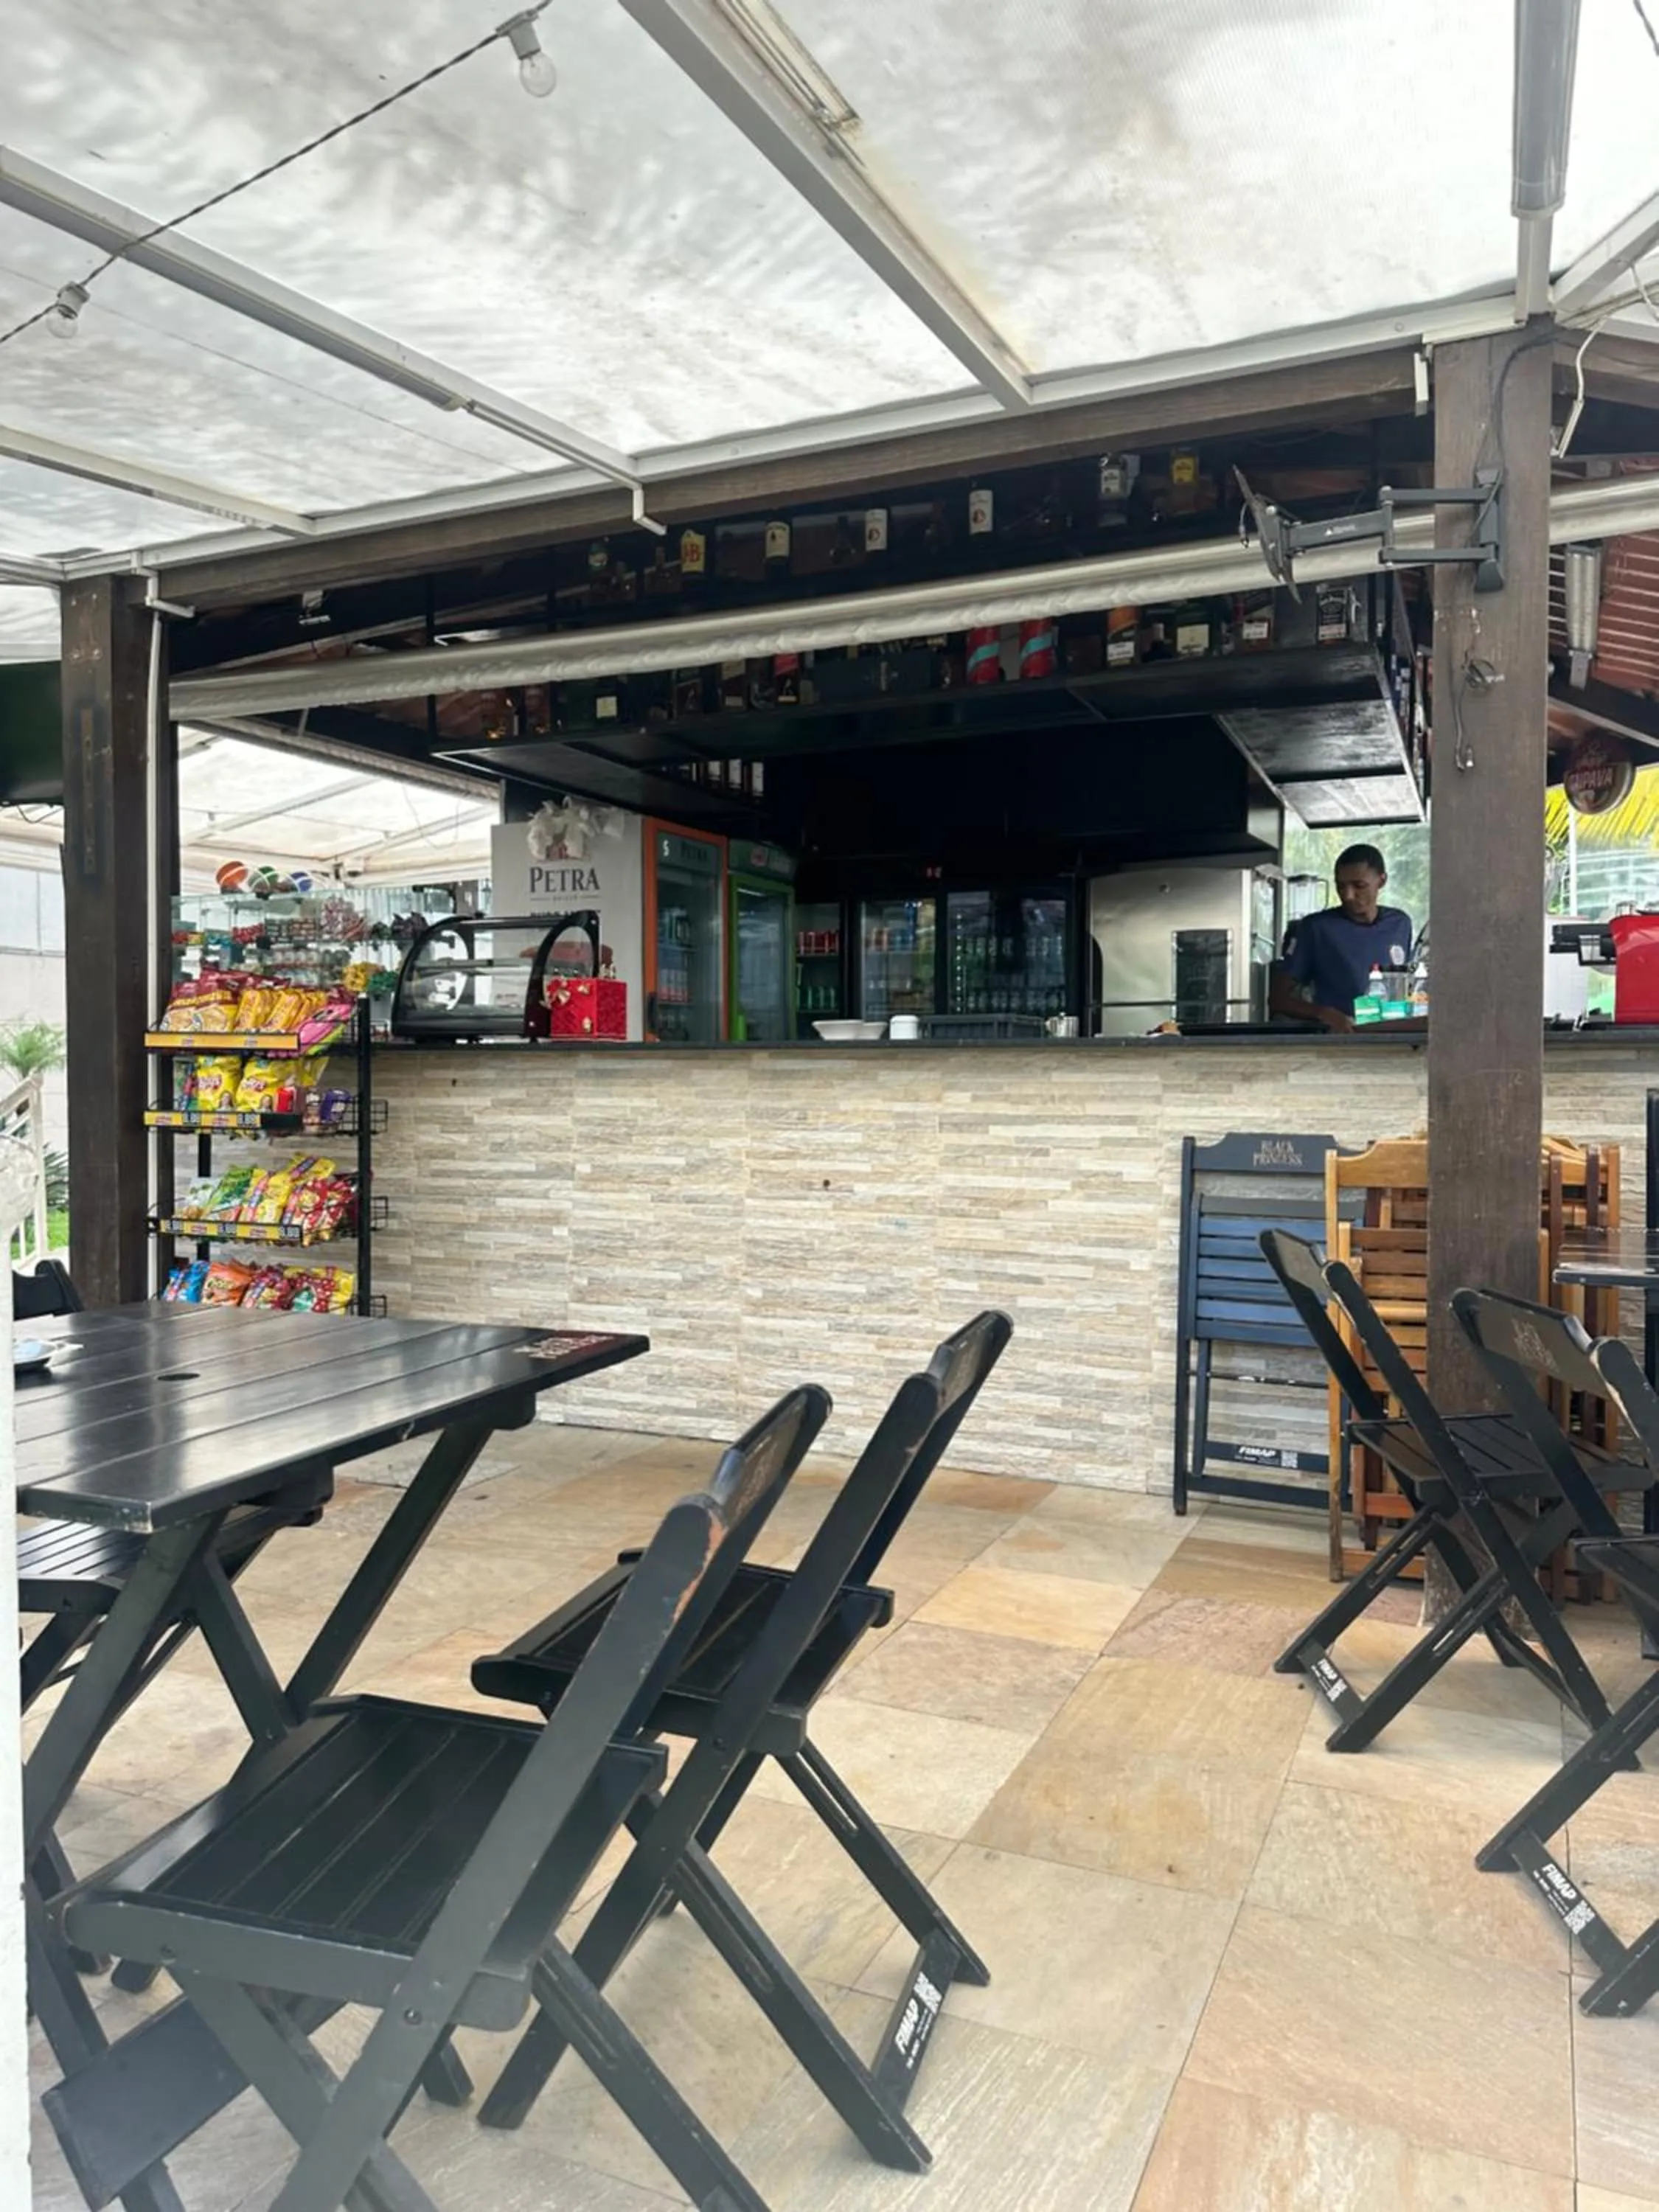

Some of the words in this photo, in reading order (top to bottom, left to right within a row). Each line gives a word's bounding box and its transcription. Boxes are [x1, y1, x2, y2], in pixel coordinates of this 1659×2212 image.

[529, 866, 600, 893] PETRA
[1542, 1863, 1577, 1899] FIMAP
[894, 1997, 919, 2056] FIMAP
